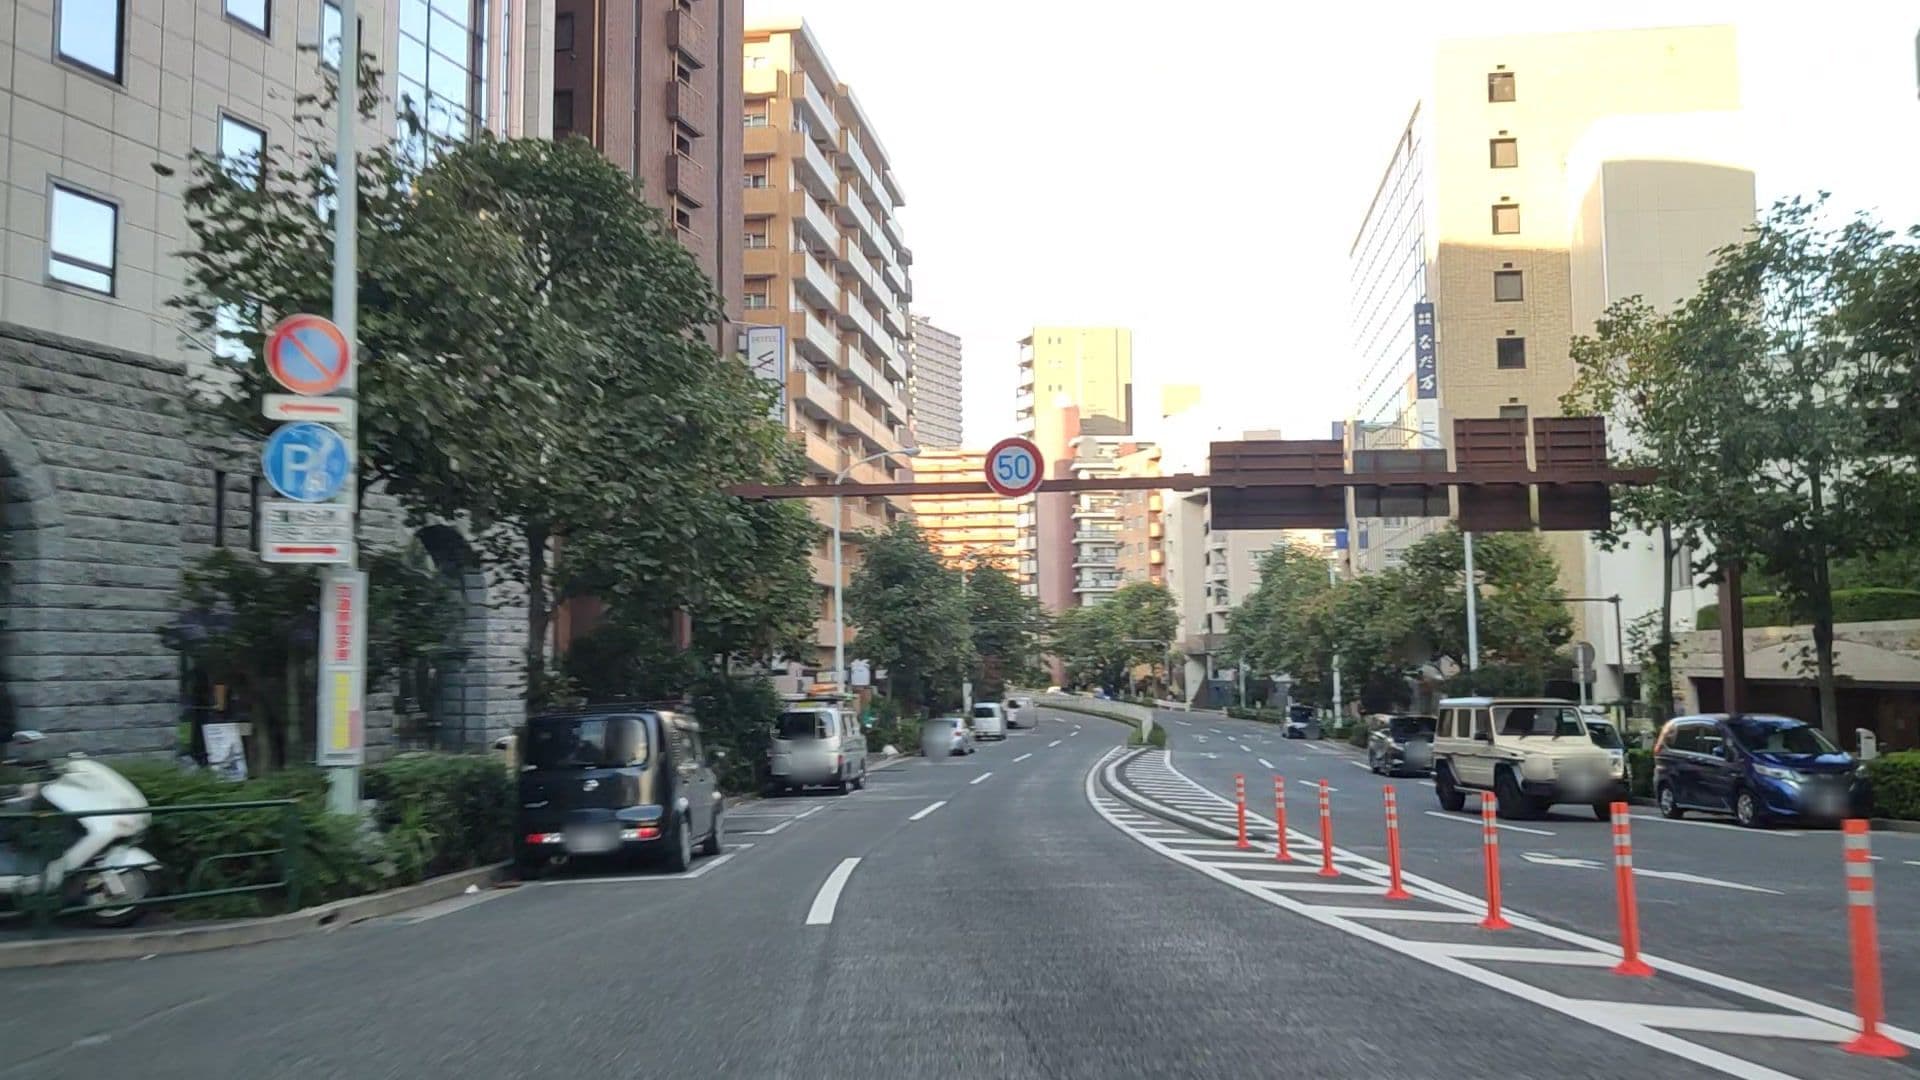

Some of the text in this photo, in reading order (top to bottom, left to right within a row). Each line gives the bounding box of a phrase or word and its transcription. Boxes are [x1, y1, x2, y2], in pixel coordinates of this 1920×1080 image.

[1418, 334, 1435, 390] なだ万
[998, 454, 1030, 481] 50
